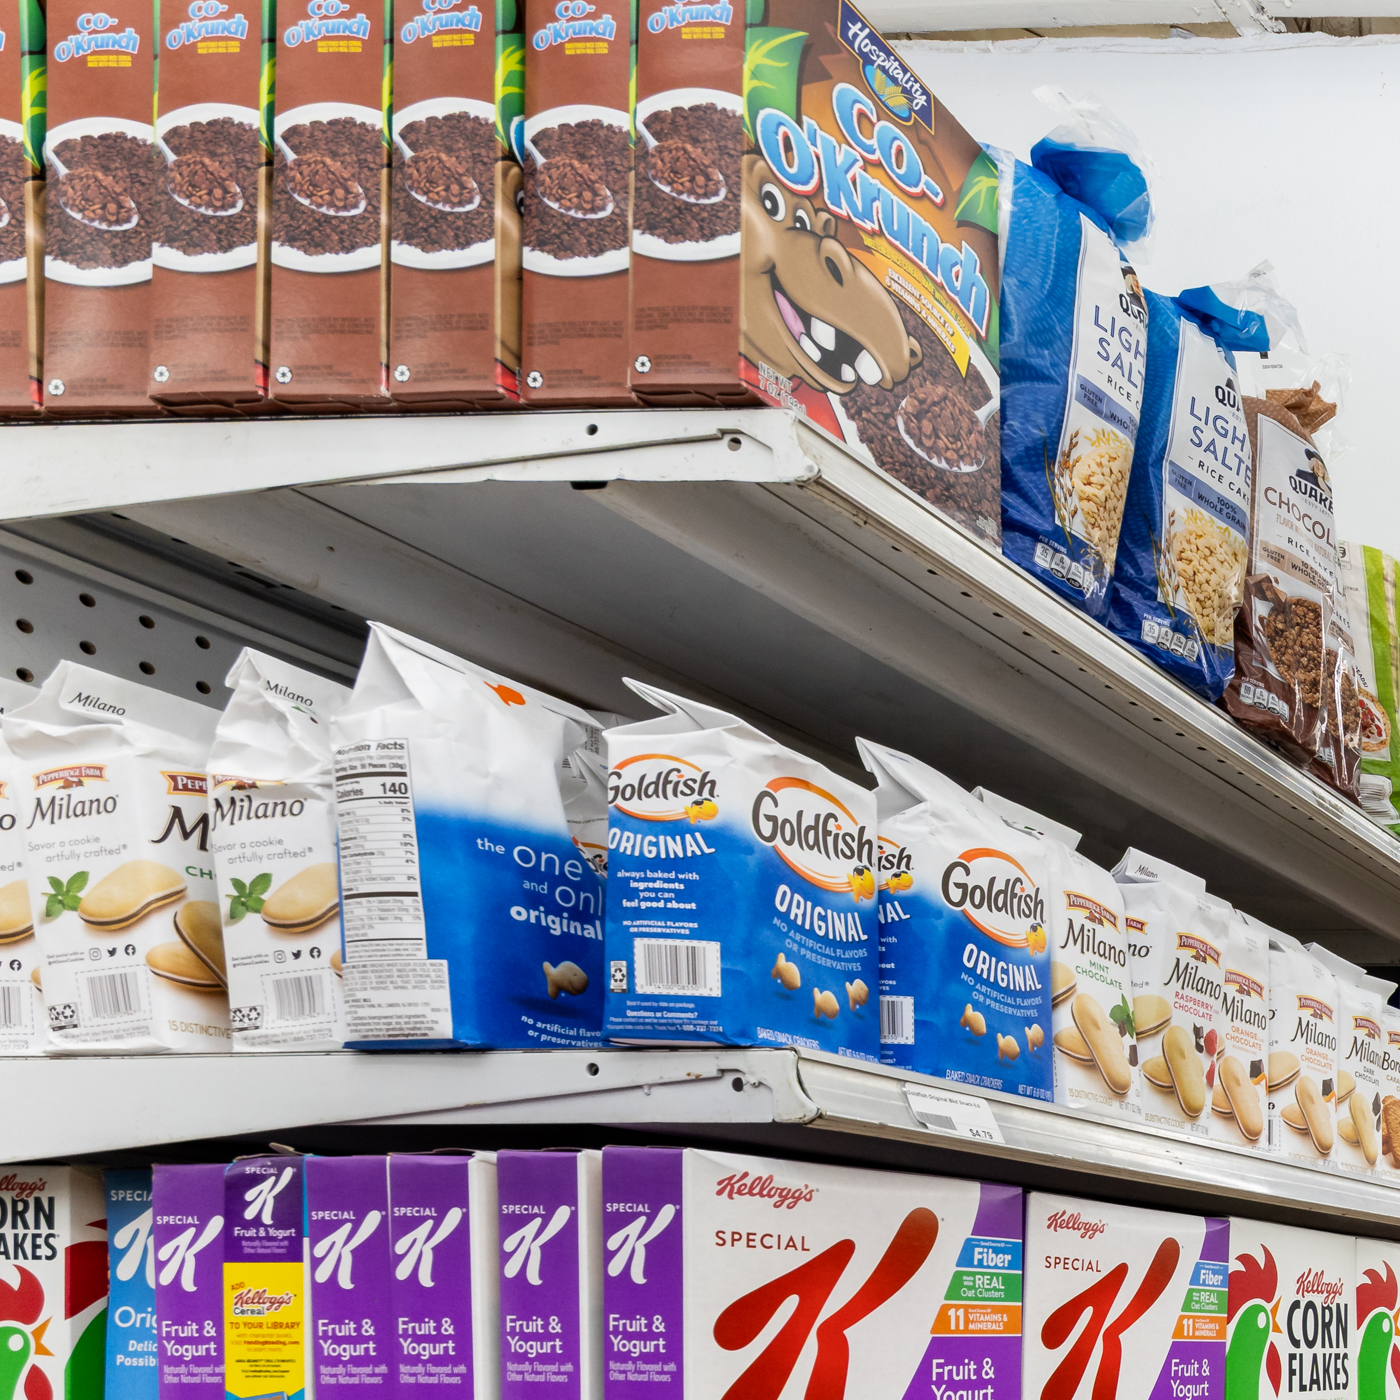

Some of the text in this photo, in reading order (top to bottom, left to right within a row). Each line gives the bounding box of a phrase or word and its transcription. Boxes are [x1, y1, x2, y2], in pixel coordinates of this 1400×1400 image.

[848, 20, 927, 110] Hospitality
[755, 107, 991, 340] O'Krunch
[888, 268, 955, 337] EXCELLENT SOURCE OF
[1198, 460, 1224, 484] RICE
[1197, 492, 1224, 516] WHOLE
[1217, 496, 1237, 514] 100%
[68, 691, 127, 717] Milano
[39, 766, 100, 785] PEPPERIDGE FARM
[379, 781, 409, 797] 140
[26, 794, 117, 829] Milano
[752, 790, 876, 868] Goldfish
[476, 837, 583, 881] the one
[617, 869, 699, 881] always baked with
[630, 880, 684, 891] ingredients
[509, 904, 603, 939] original
[774, 884, 868, 943] ORIGINAL
[1061, 917, 1127, 967] Milano
[1075, 965, 1123, 991] CHOCOLATE
[1089, 959, 1110, 975] MINT
[1174, 990, 1214, 1013] RASPBERRY
[969, 1128, 993, 1140] $4.79
[715, 1170, 815, 1210] Kellogg's
[234, 1227, 296, 1238] Fruit & Yogurt
[714, 1229, 811, 1253] SPECIAL
[973, 1247, 1012, 1268] Fiber
[975, 1275, 1005, 1289] REAL
[1295, 1268, 1344, 1299] Kellogg's
[234, 1288, 293, 1311] Kellogg's
[267, 1322, 300, 1330] LIBRARY
[948, 1308, 1001, 1331] 11 VITAMINS
[968, 1320, 1004, 1331] MINERALS
[1287, 1300, 1350, 1350] CORN
[931, 1357, 995, 1382] Fruit &
[1287, 1349, 1350, 1393] FLAKES
